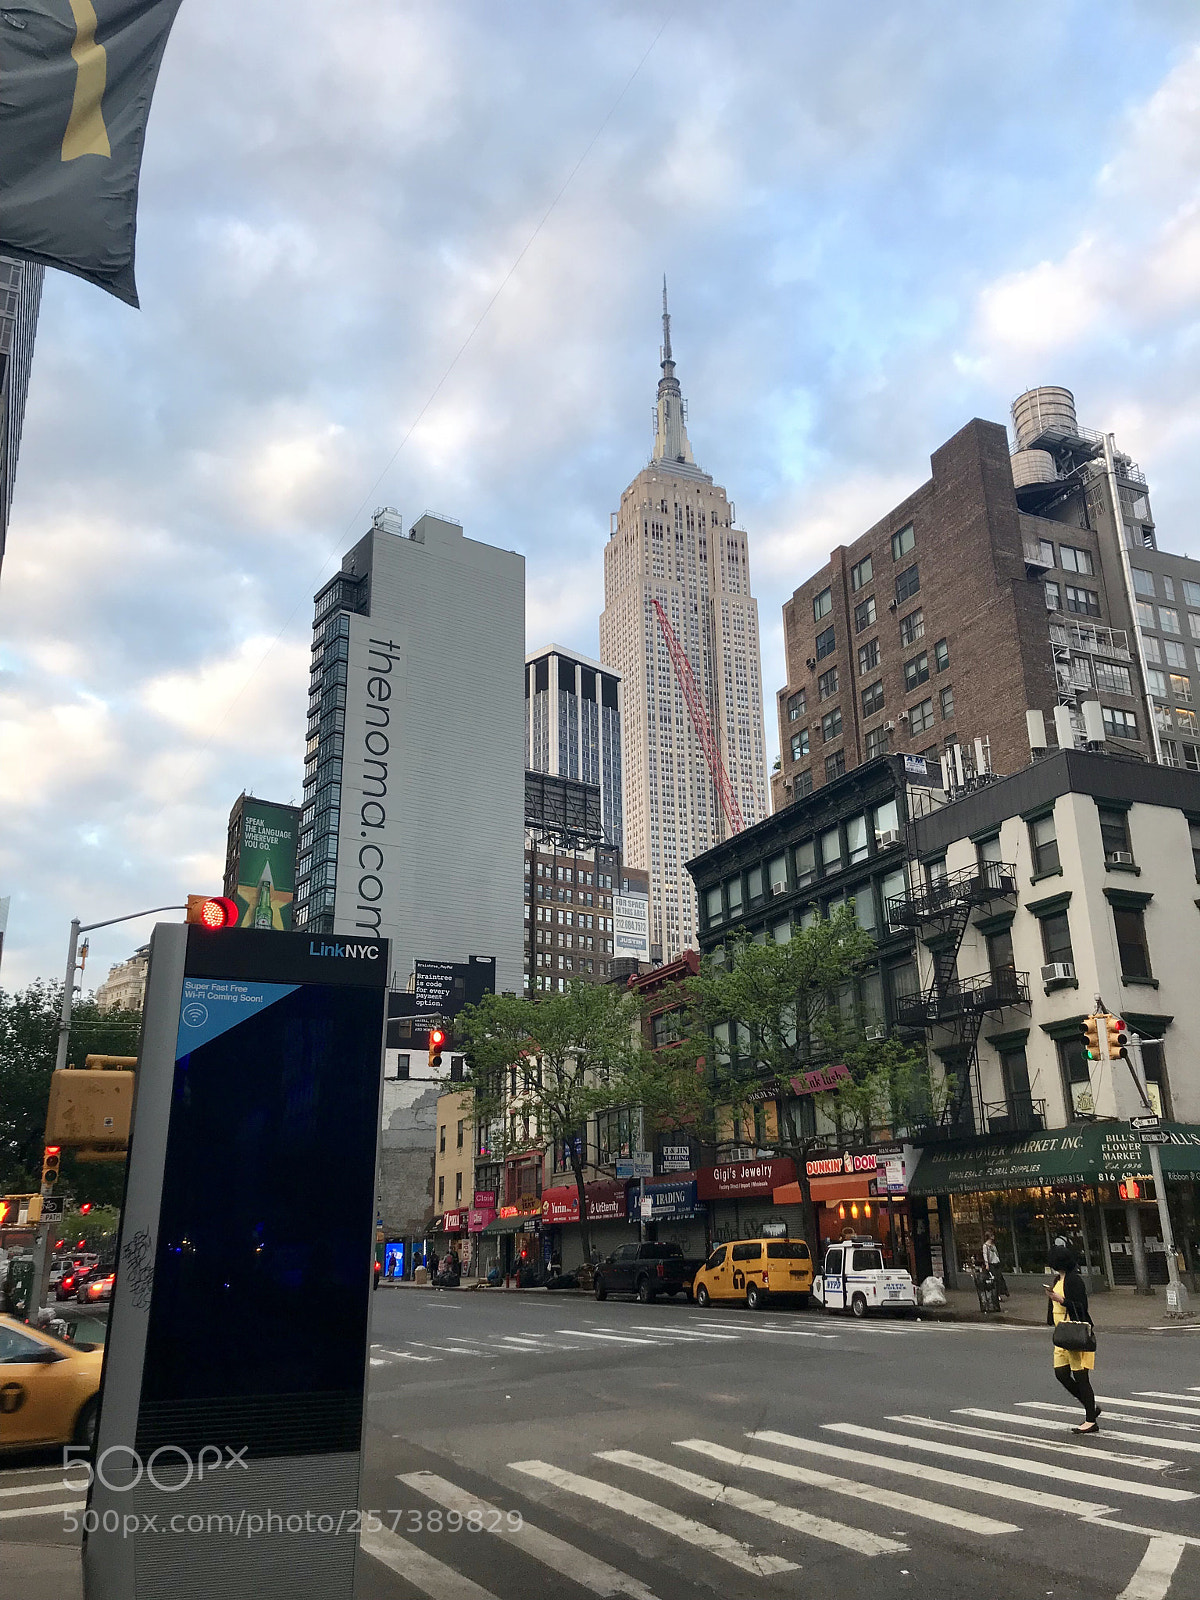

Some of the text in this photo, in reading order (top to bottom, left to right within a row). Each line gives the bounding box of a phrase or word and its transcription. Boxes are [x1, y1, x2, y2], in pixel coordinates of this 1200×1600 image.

[355, 638, 401, 938] thenoma.com
[245, 816, 265, 827] SPEAK
[245, 824, 292, 840] THE LANGUAGE
[244, 832, 279, 845] WHEREVER
[244, 839, 271, 851] YOU GO.
[615, 898, 646, 910] FOR SPACE
[309, 941, 379, 960] LinkNYC
[416, 973, 453, 981] Braintree
[185, 981, 248, 993] Super Fast Free
[429, 989, 450, 997] every
[185, 990, 264, 1003] Wi-Fi Coming Soon!
[1060, 1136, 1084, 1150] INC.
[1106, 1134, 1136, 1142] BILL'S
[1170, 1133, 1200, 1146] ILL'S
[1101, 1142, 1141, 1152] FLOWER
[1102, 1152, 1142, 1160] MARKET
[806, 1154, 877, 1175] DUNKIN' DON
[1009, 1164, 1041, 1174] SUPPLIES
[713, 1164, 773, 1182] Gigi's Jewelry
[1098, 1173, 1116, 1181] 816
[656, 1191, 685, 1206] TRADING
[827, 1281, 841, 1289] NYPD
